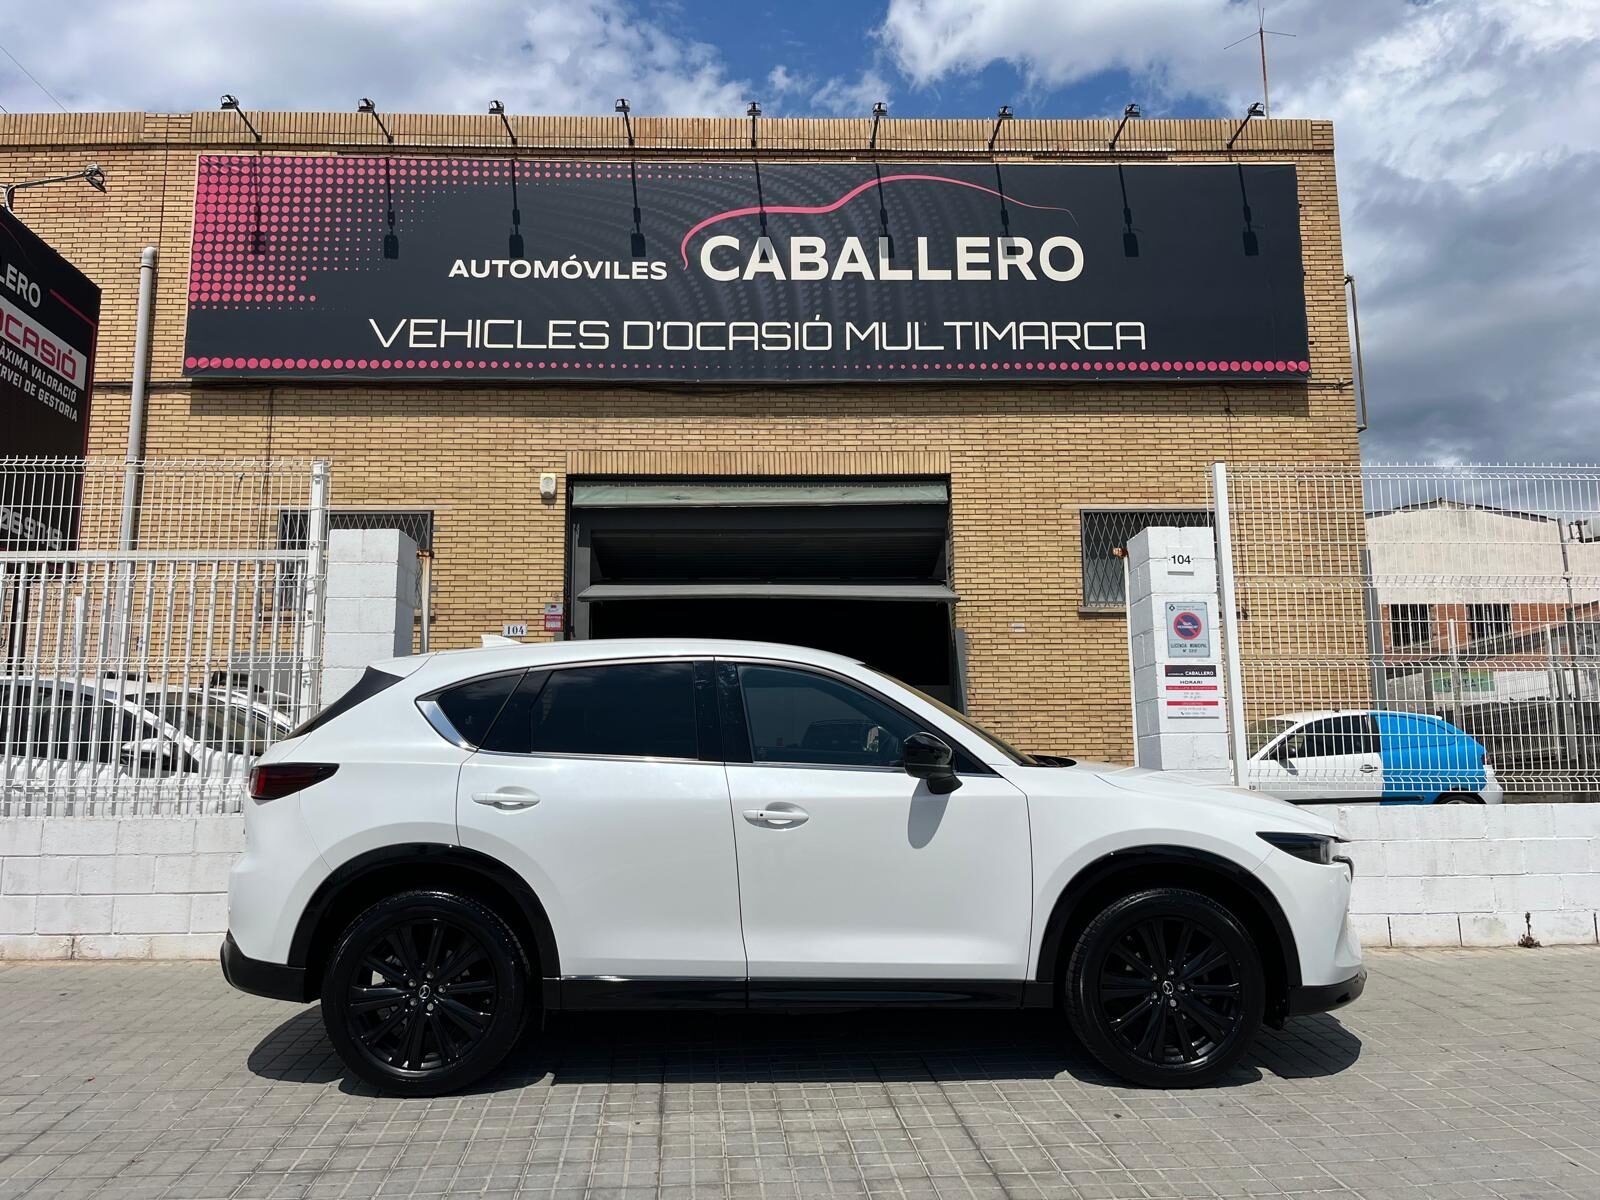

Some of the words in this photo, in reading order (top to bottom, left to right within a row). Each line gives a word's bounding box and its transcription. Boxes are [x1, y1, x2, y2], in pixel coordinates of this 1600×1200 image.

[448, 255, 668, 281] AUTOMÓVILES
[700, 235, 1085, 282] CABALLERO
[368, 318, 610, 351] VEHICLES
[623, 314, 833, 352] D'OCASIÓ
[845, 320, 1147, 351] MULTIMARCA
[24, 379, 37, 397] DE
[38, 387, 78, 422] GESTORIA
[31, 364, 77, 402] VALORACIÓ
[1171, 555, 1191, 564] 104
[507, 625, 524, 635] 104
